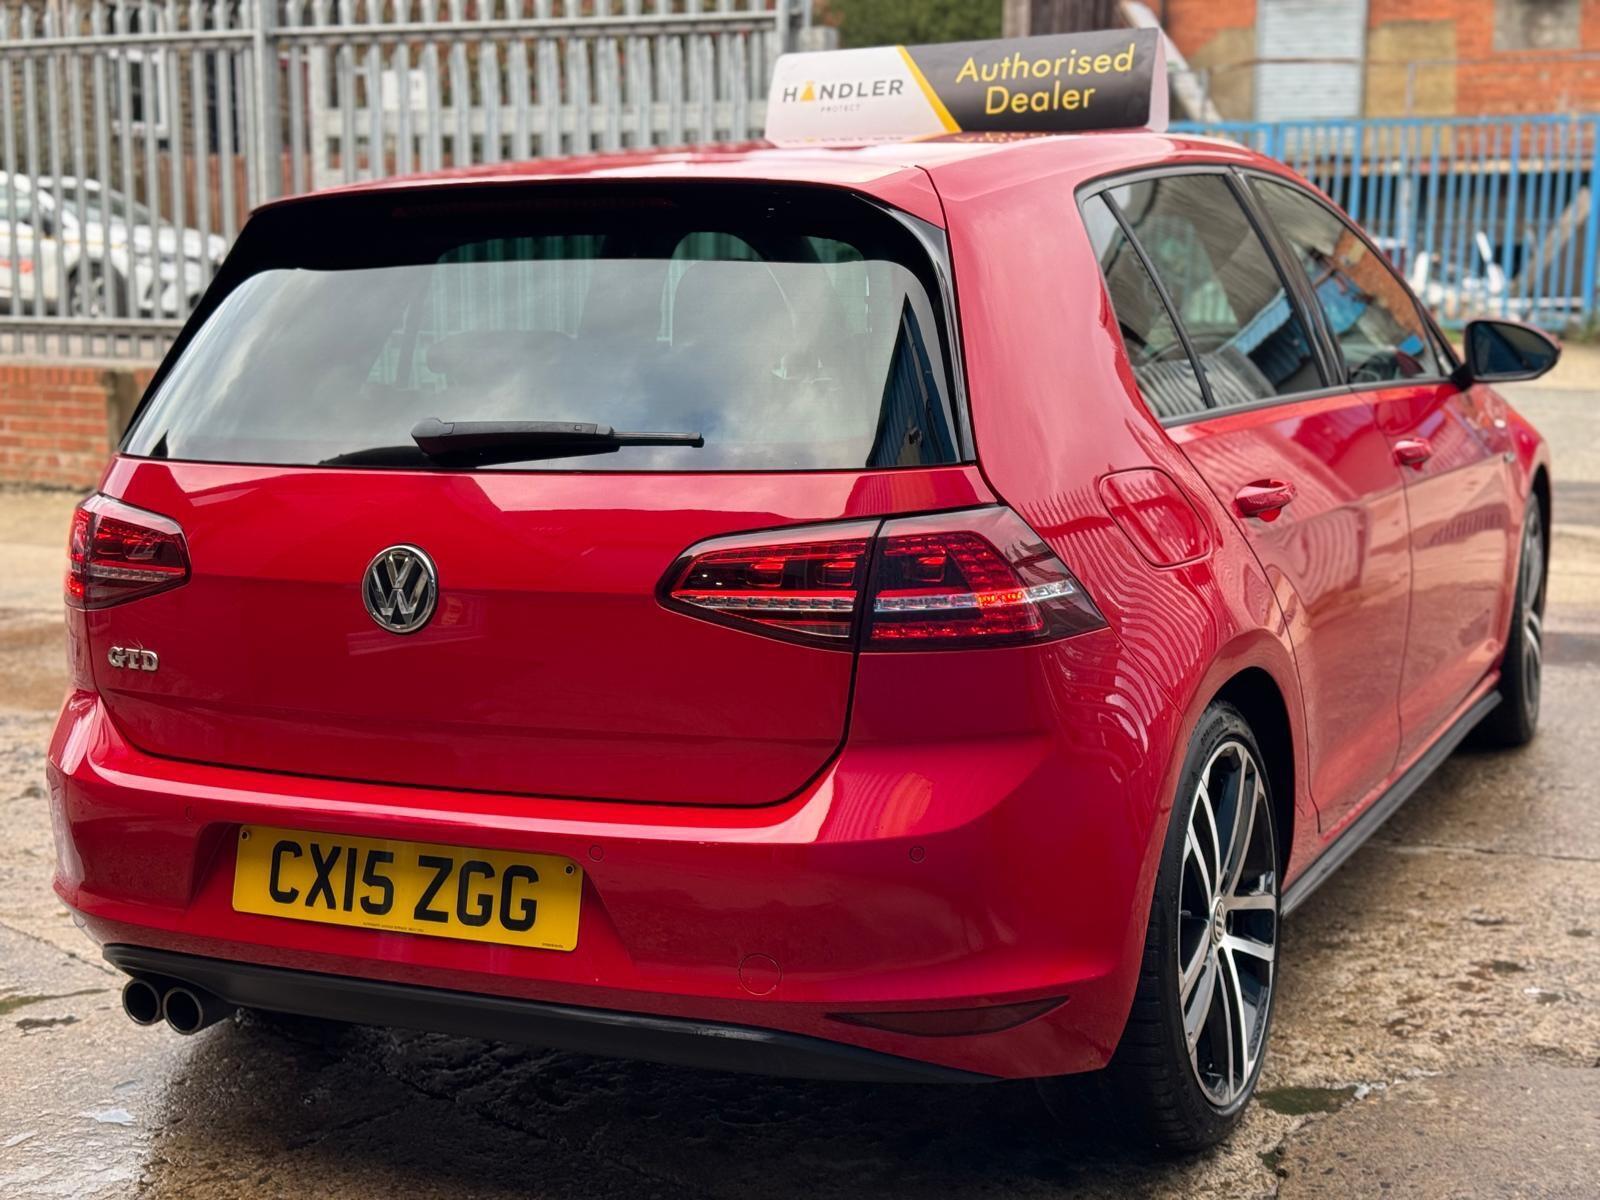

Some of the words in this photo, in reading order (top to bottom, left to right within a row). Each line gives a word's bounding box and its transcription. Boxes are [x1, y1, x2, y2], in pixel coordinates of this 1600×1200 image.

[955, 43, 1135, 83] Authorised
[985, 80, 1096, 115] Dealer
[108, 646, 158, 671] GTD
[269, 840, 394, 915] CX15
[413, 855, 540, 932] ZGG
